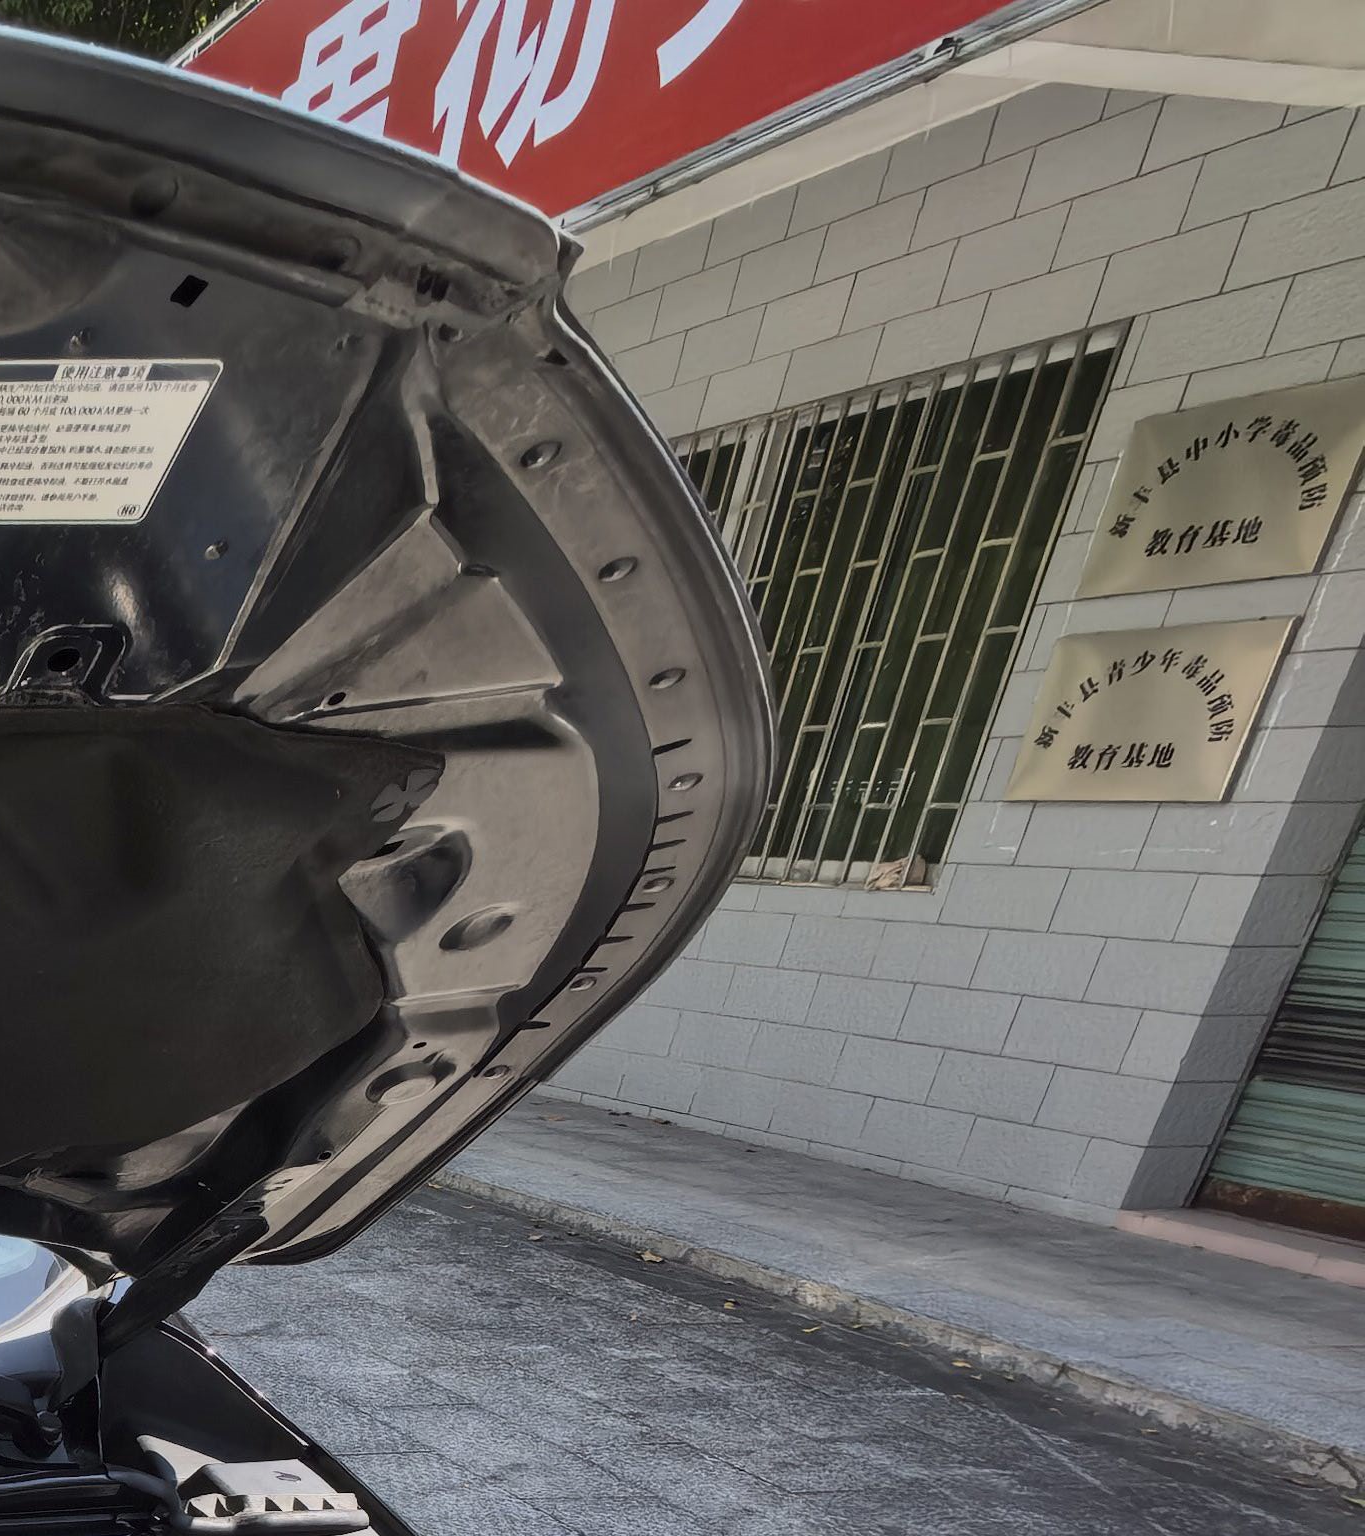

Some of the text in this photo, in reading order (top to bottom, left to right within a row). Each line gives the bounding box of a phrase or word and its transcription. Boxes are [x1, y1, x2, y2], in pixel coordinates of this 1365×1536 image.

[1144, 515, 1264, 558] 教育基地
[1067, 741, 1175, 774] 教育基地
